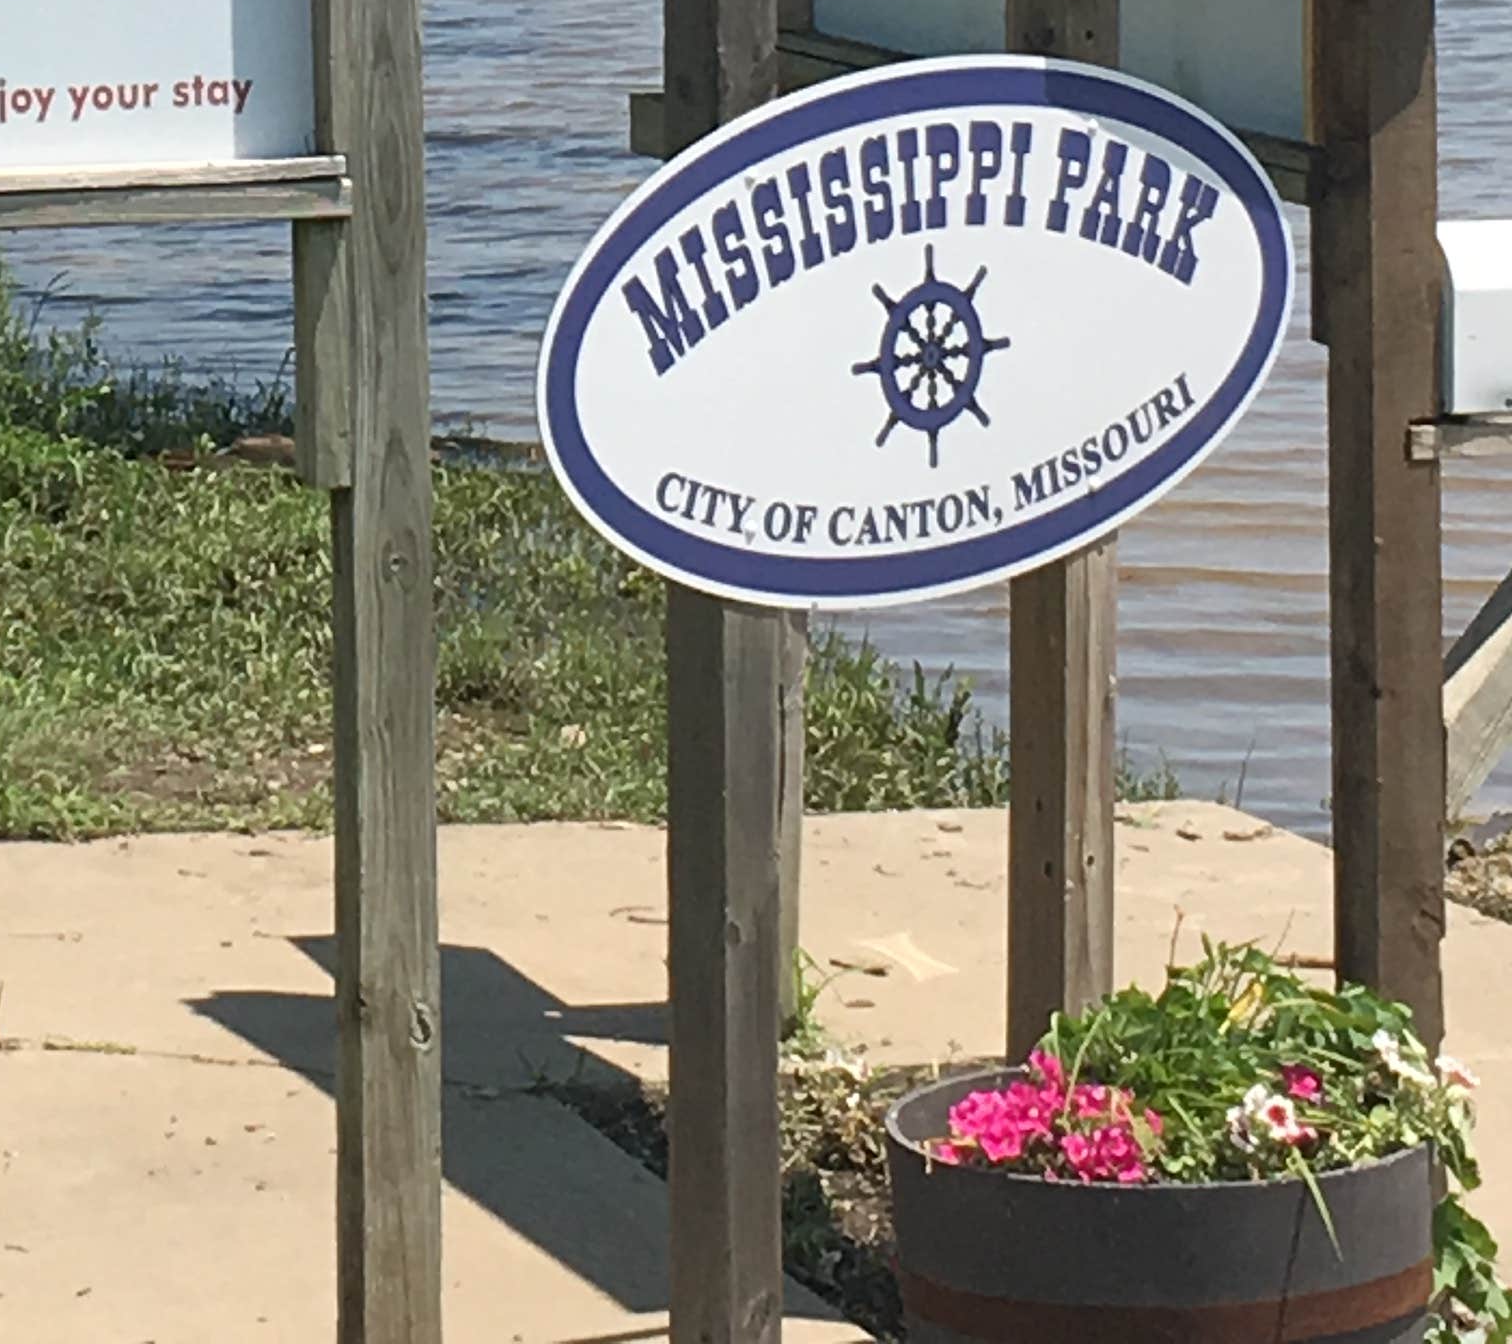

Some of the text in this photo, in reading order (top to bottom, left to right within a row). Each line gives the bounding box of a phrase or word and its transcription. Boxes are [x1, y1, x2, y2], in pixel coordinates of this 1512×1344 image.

[67, 83, 159, 121] your
[173, 72, 253, 117] stay
[620, 120, 1222, 377] MISSISSIPPI PARK
[654, 372, 1197, 548] CITY OF CANTON, MISSOURI
